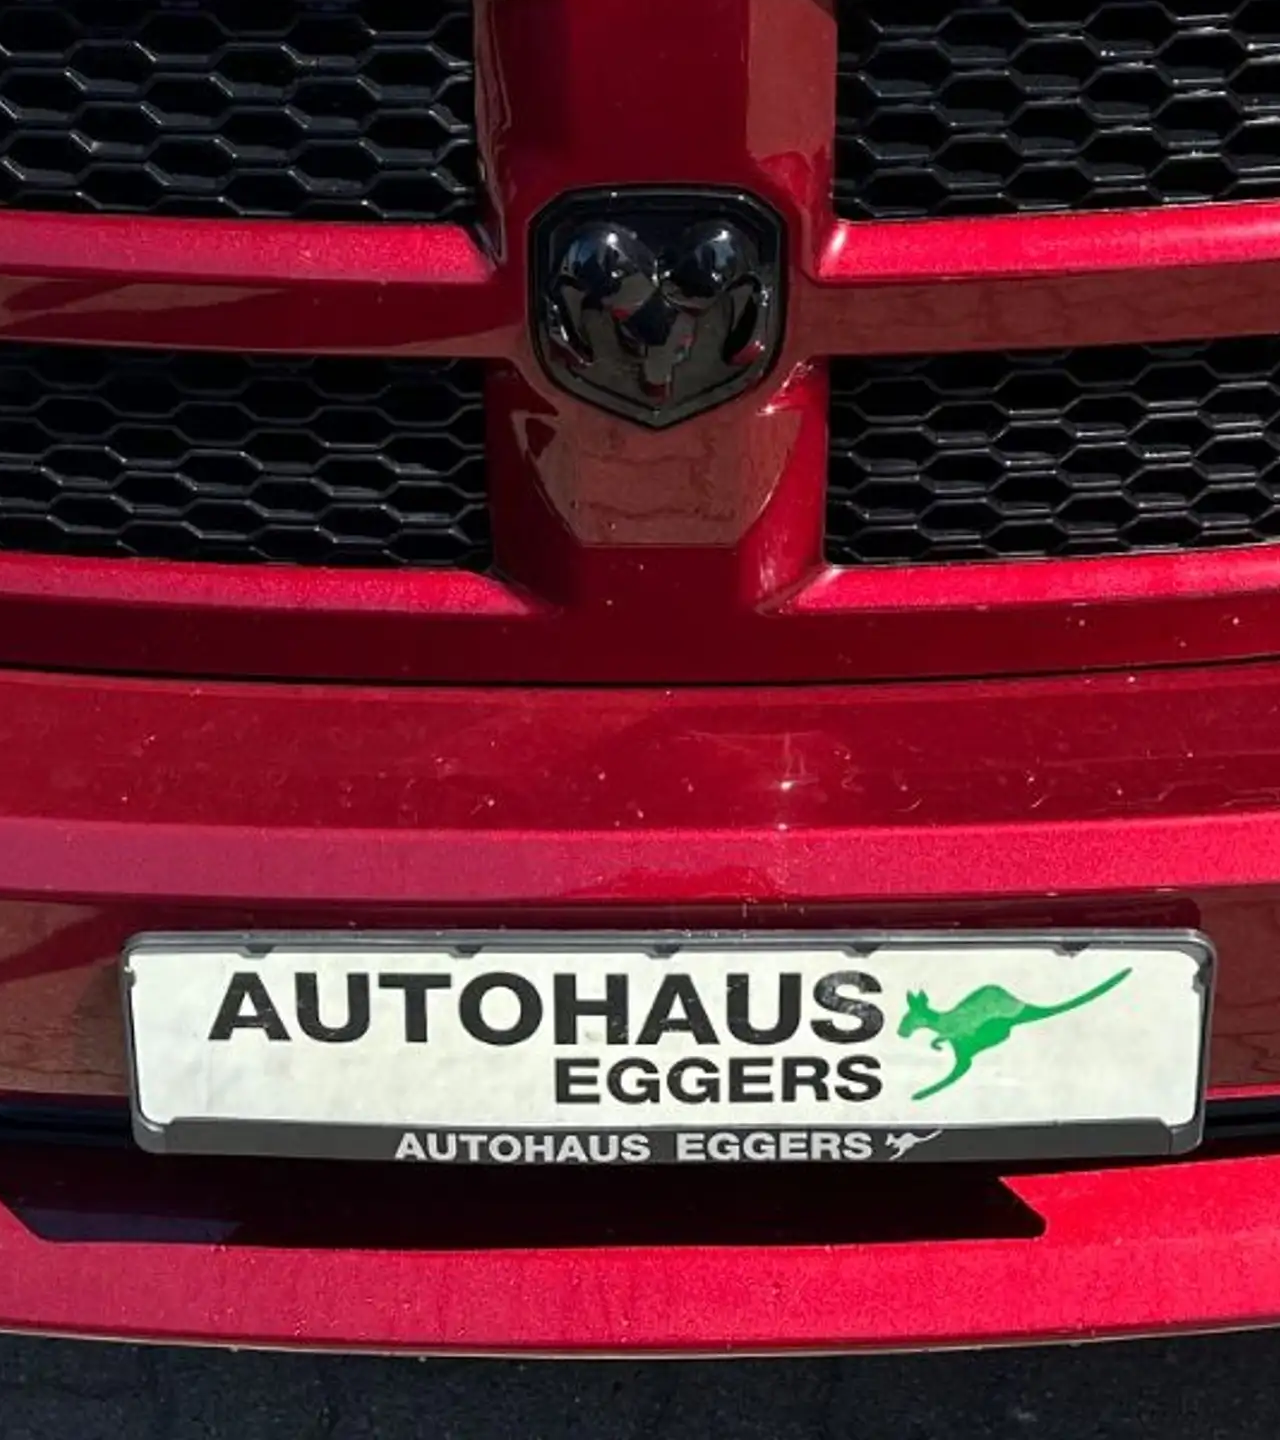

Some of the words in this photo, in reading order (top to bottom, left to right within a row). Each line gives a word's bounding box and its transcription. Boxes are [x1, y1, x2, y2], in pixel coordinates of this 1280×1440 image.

[208, 970, 885, 1046] AUTOHAUS
[554, 1055, 884, 1105] EGGERS
[395, 1131, 651, 1163] AUTOHAUS
[677, 1130, 874, 1162] EGGERS
